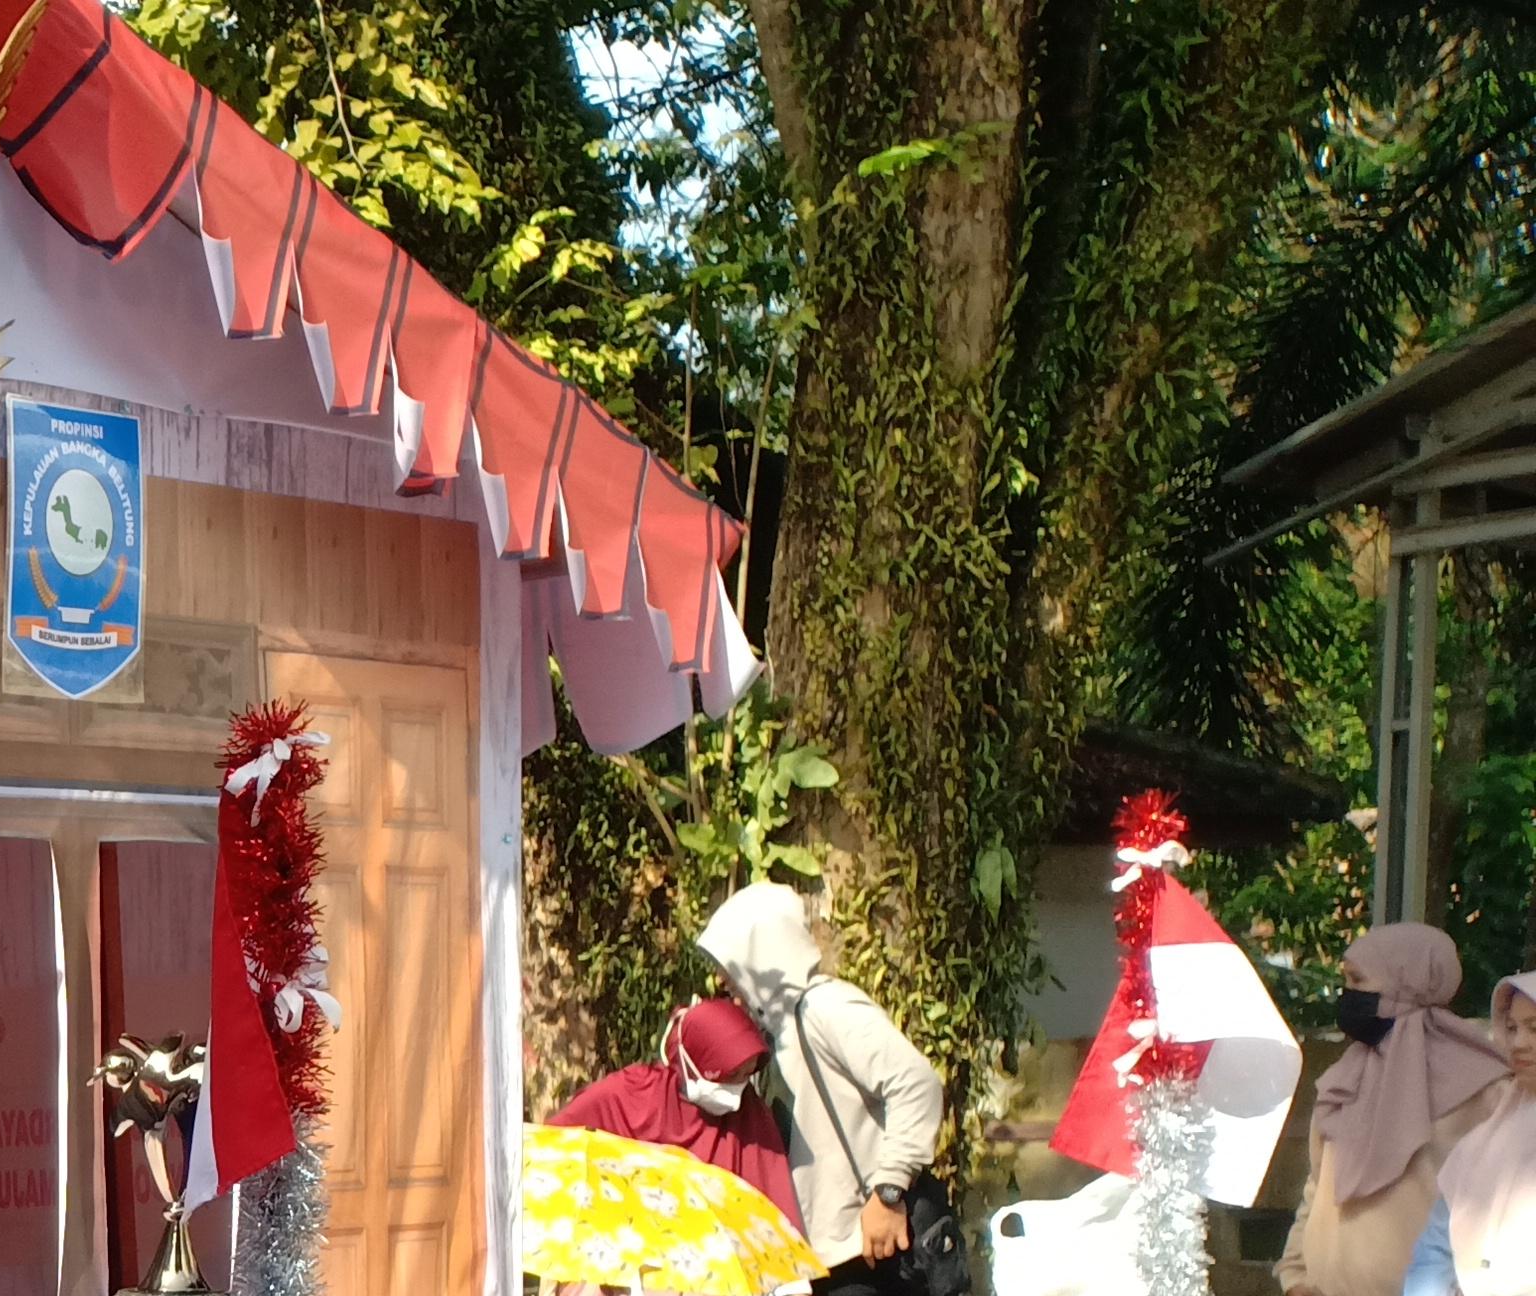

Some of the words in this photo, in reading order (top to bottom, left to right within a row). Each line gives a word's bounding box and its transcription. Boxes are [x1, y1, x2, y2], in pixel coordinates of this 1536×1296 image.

[50, 418, 104, 439] PROPINSI
[23, 447, 60, 536] KEPULAUAN
[61, 440, 108, 468] BANGKA
[107, 465, 135, 547] BELITUNG
